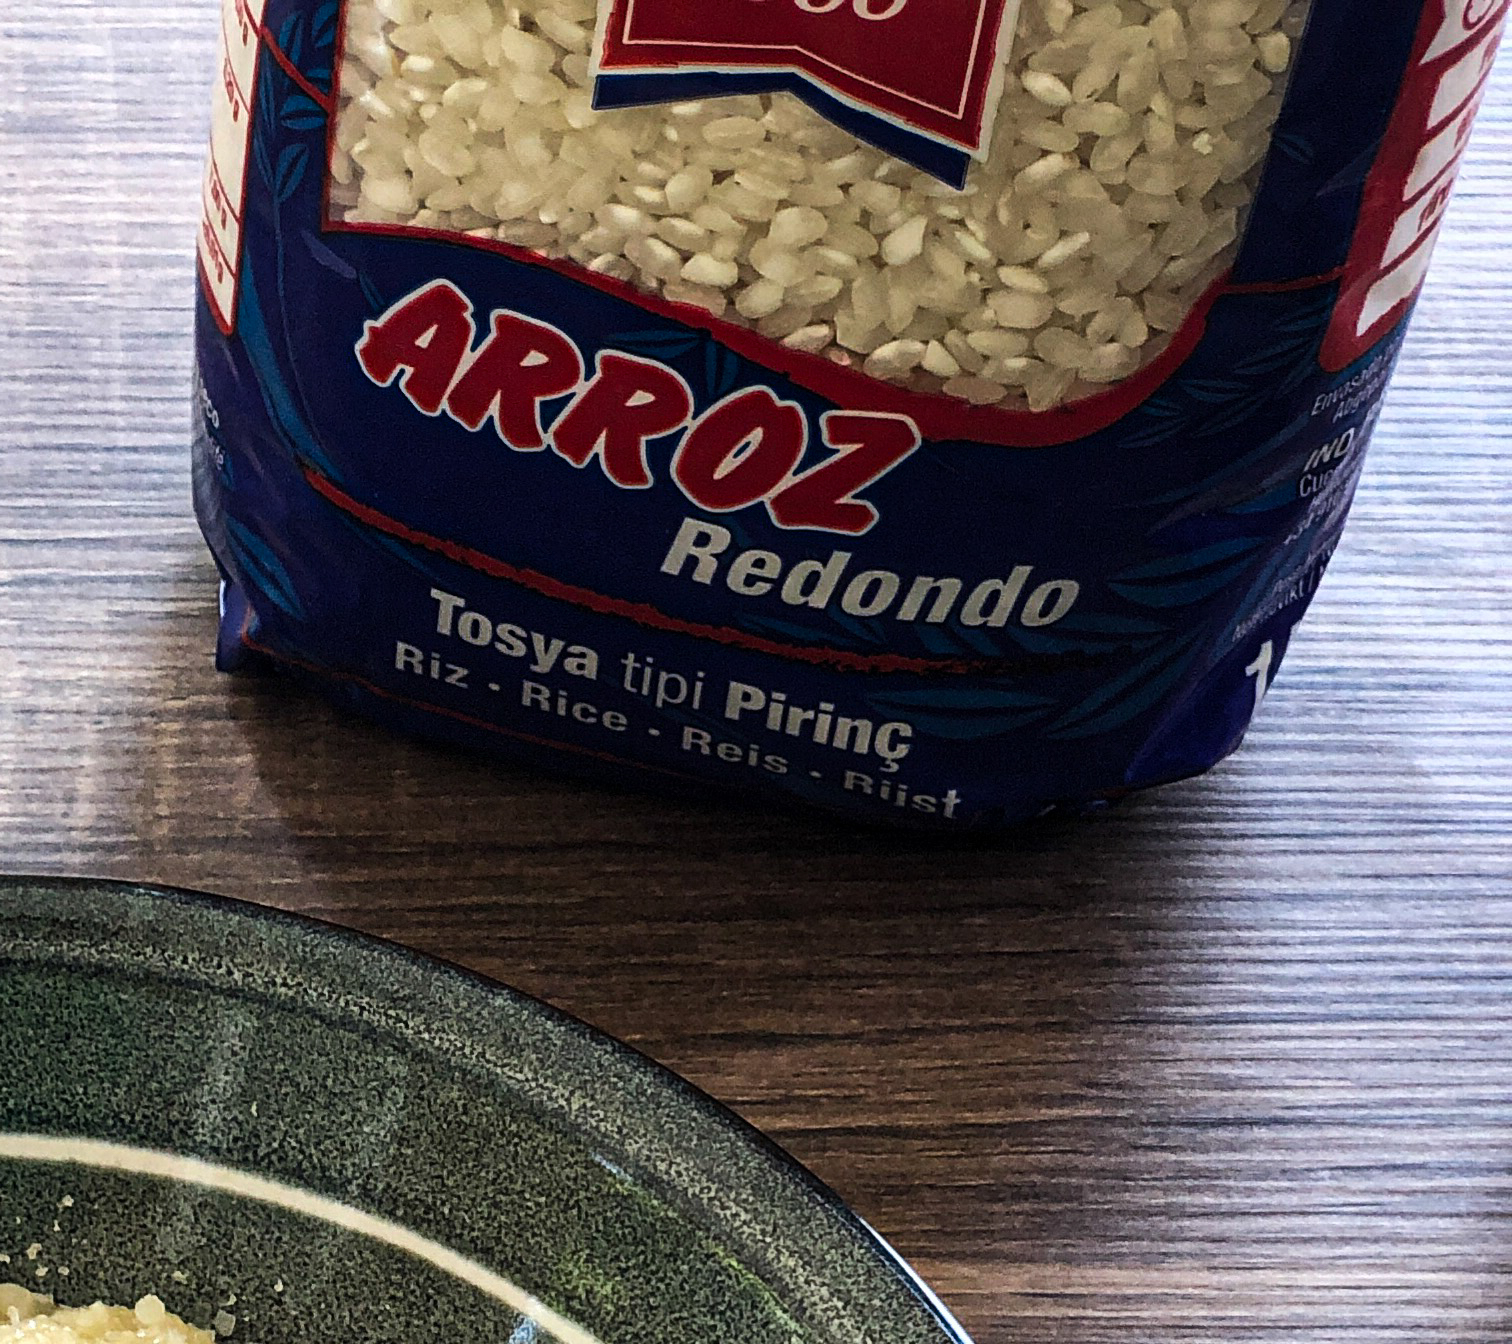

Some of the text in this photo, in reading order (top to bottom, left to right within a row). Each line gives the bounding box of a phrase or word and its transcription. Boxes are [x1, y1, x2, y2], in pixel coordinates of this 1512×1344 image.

[355, 279, 921, 535] ARROZ
[659, 517, 1080, 628] Redondo
[394, 641, 470, 689] Riz
[520, 680, 629, 733] Rice
[682, 725, 789, 775] Reis
[430, 588, 913, 773] Tosya tipi Pirinç
